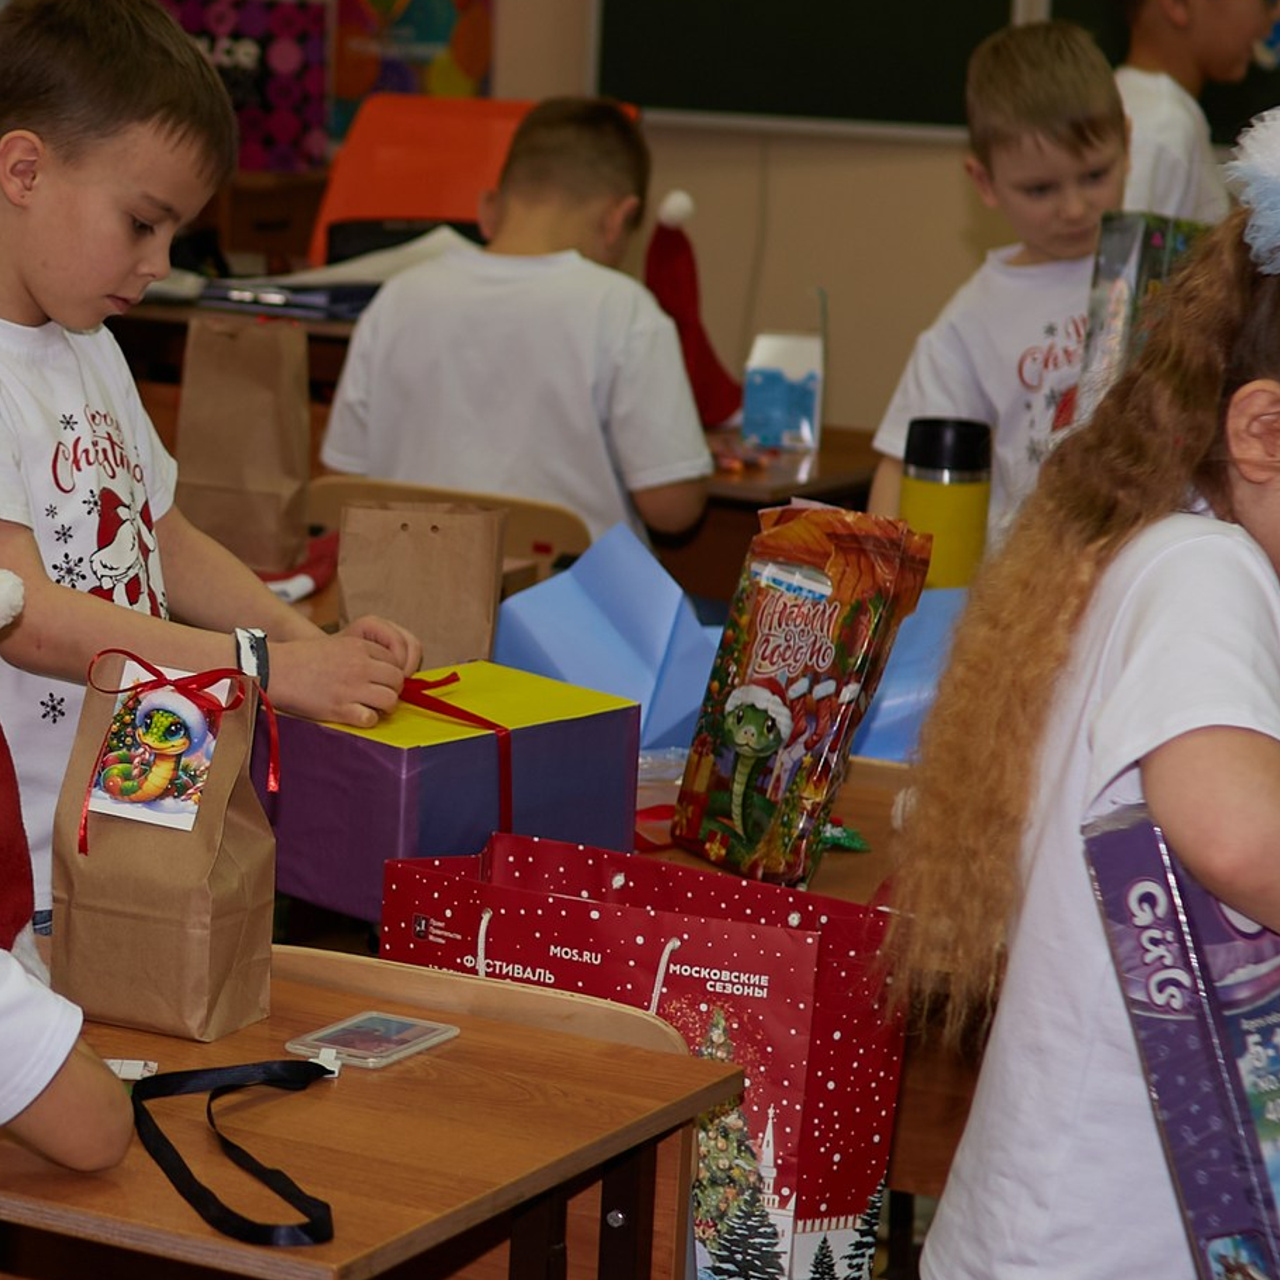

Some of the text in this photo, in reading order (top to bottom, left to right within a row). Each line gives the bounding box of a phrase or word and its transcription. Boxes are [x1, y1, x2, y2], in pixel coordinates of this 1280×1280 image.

[549, 944, 602, 966] MOS.RU
[1128, 880, 1192, 1011] Girls
[462, 954, 556, 985] ФСТИВАЛЬ
[669, 963, 769, 987] МОСКОВСКИЕ
[706, 980, 768, 998] СЕЗОНЫ
